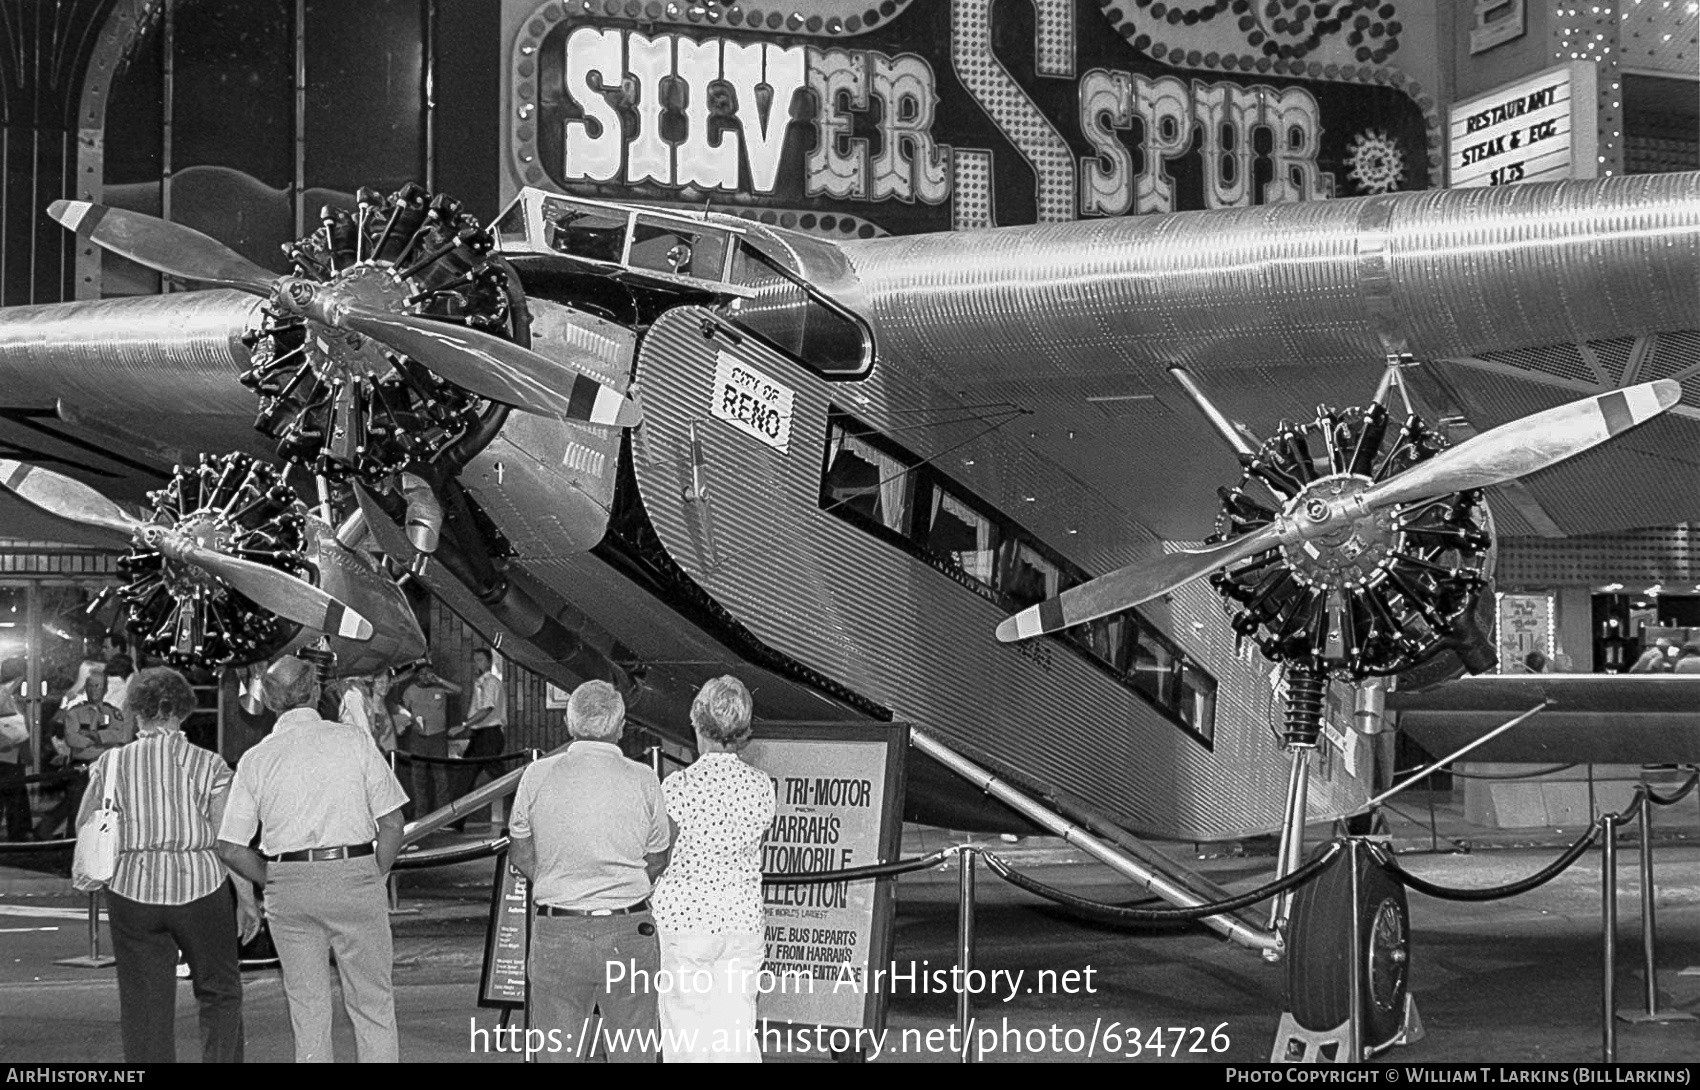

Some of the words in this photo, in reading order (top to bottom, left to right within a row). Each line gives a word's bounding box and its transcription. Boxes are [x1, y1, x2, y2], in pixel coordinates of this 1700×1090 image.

[564, 26, 952, 204] SILVER
[1079, 67, 1337, 217] SPUR
[1466, 85, 1558, 135] RESTAURANT
[1461, 134, 1506, 167] STEAK
[1509, 130, 1521, 150] &
[731, 367, 760, 391] CITY
[762, 385, 780, 404] OF
[722, 383, 781, 439] RENO
[785, 776, 872, 807] TRI-MOTOR
[759, 844, 853, 873] UTOMOBILE
[764, 925, 786, 942] AVE.
[788, 927, 810, 943] BUS
[811, 928, 857, 946] DEPARTS
[776, 944, 805, 961] FROM
[806, 946, 853, 963] HARRAH'S
